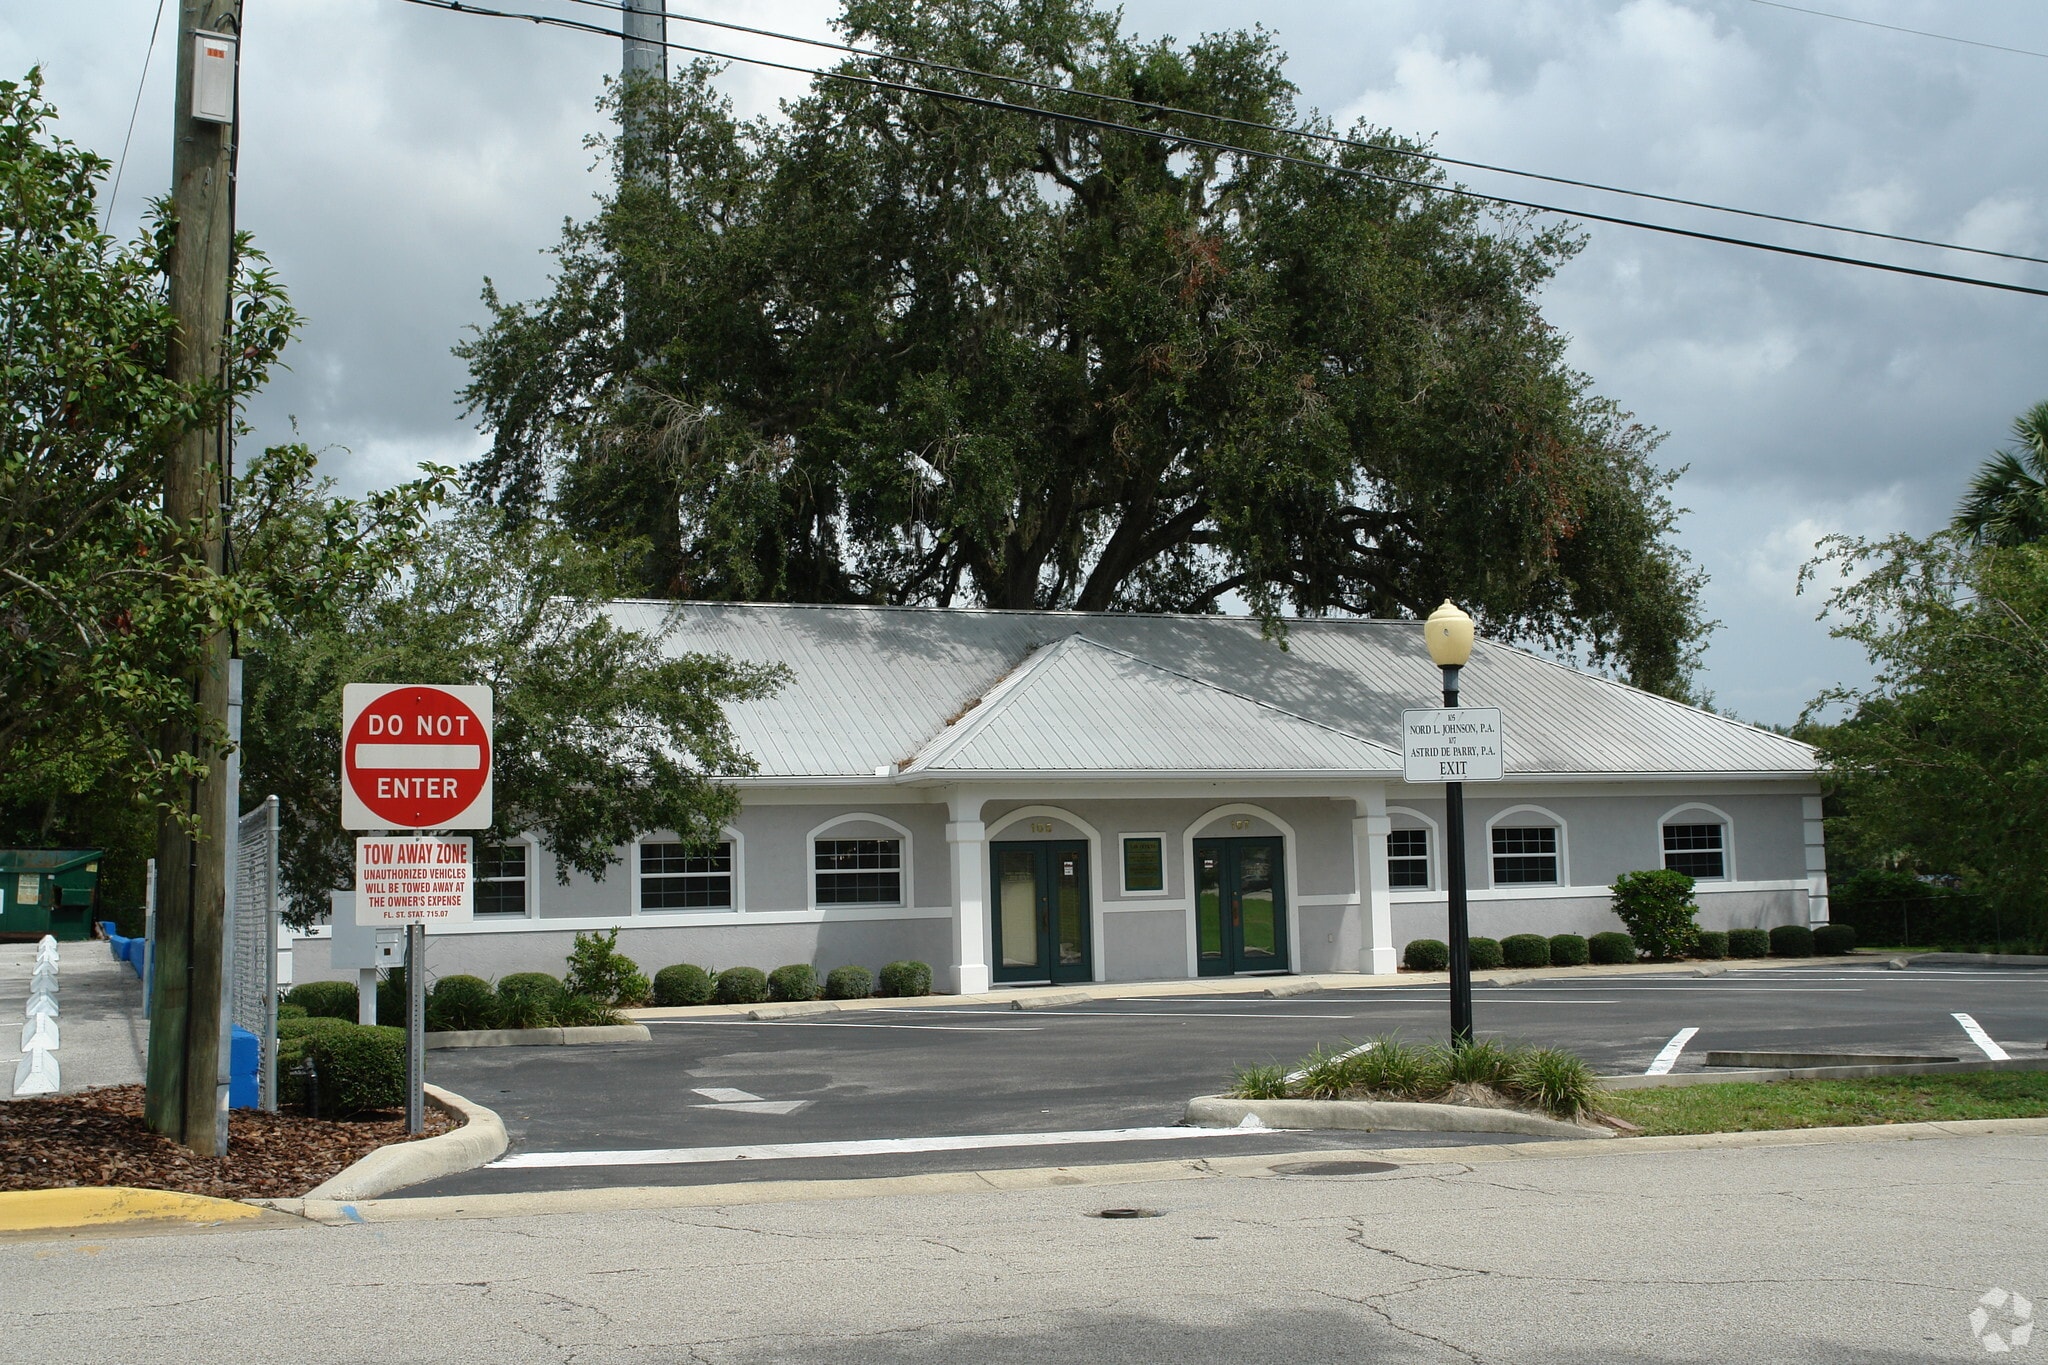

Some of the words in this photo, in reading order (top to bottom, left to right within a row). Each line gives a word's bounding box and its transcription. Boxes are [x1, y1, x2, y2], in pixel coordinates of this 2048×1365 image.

[368, 714, 404, 736] DO
[417, 715, 469, 737] NOT
[1410, 725, 1432, 735] NORD
[1433, 725, 1441, 734] L.
[1442, 724, 1478, 736] JOHNSON,
[1480, 723, 1495, 733] P.A.
[1411, 747, 1439, 757] ASTRID
[1441, 747, 1451, 757] DE
[1453, 746, 1479, 757] PARRY,
[1481, 746, 1496, 756] P.A.
[1439, 761, 1468, 776] EXIT
[377, 777, 458, 799] ENTER
[363, 844, 394, 865] TOW
[397, 843, 433, 864] AWAY
[436, 843, 467, 864] ZONE
[363, 869, 428, 880] UNAUTHORIZED
[429, 868, 467, 879] VEHICLES
[365, 883, 386, 894] WILL
[388, 883, 399, 893] BE
[401, 882, 431, 893] TOWED
[432, 882, 454, 892] AWAY
[455, 882, 465, 892] AT
[369, 897, 385, 907] THE
[387, 896, 426, 907] OWNER'S
[427, 895, 462, 906] EXPENSE
[383, 911, 394, 919] FL.
[395, 911, 406, 919] ST.
[426, 910, 449, 918] 715.07
